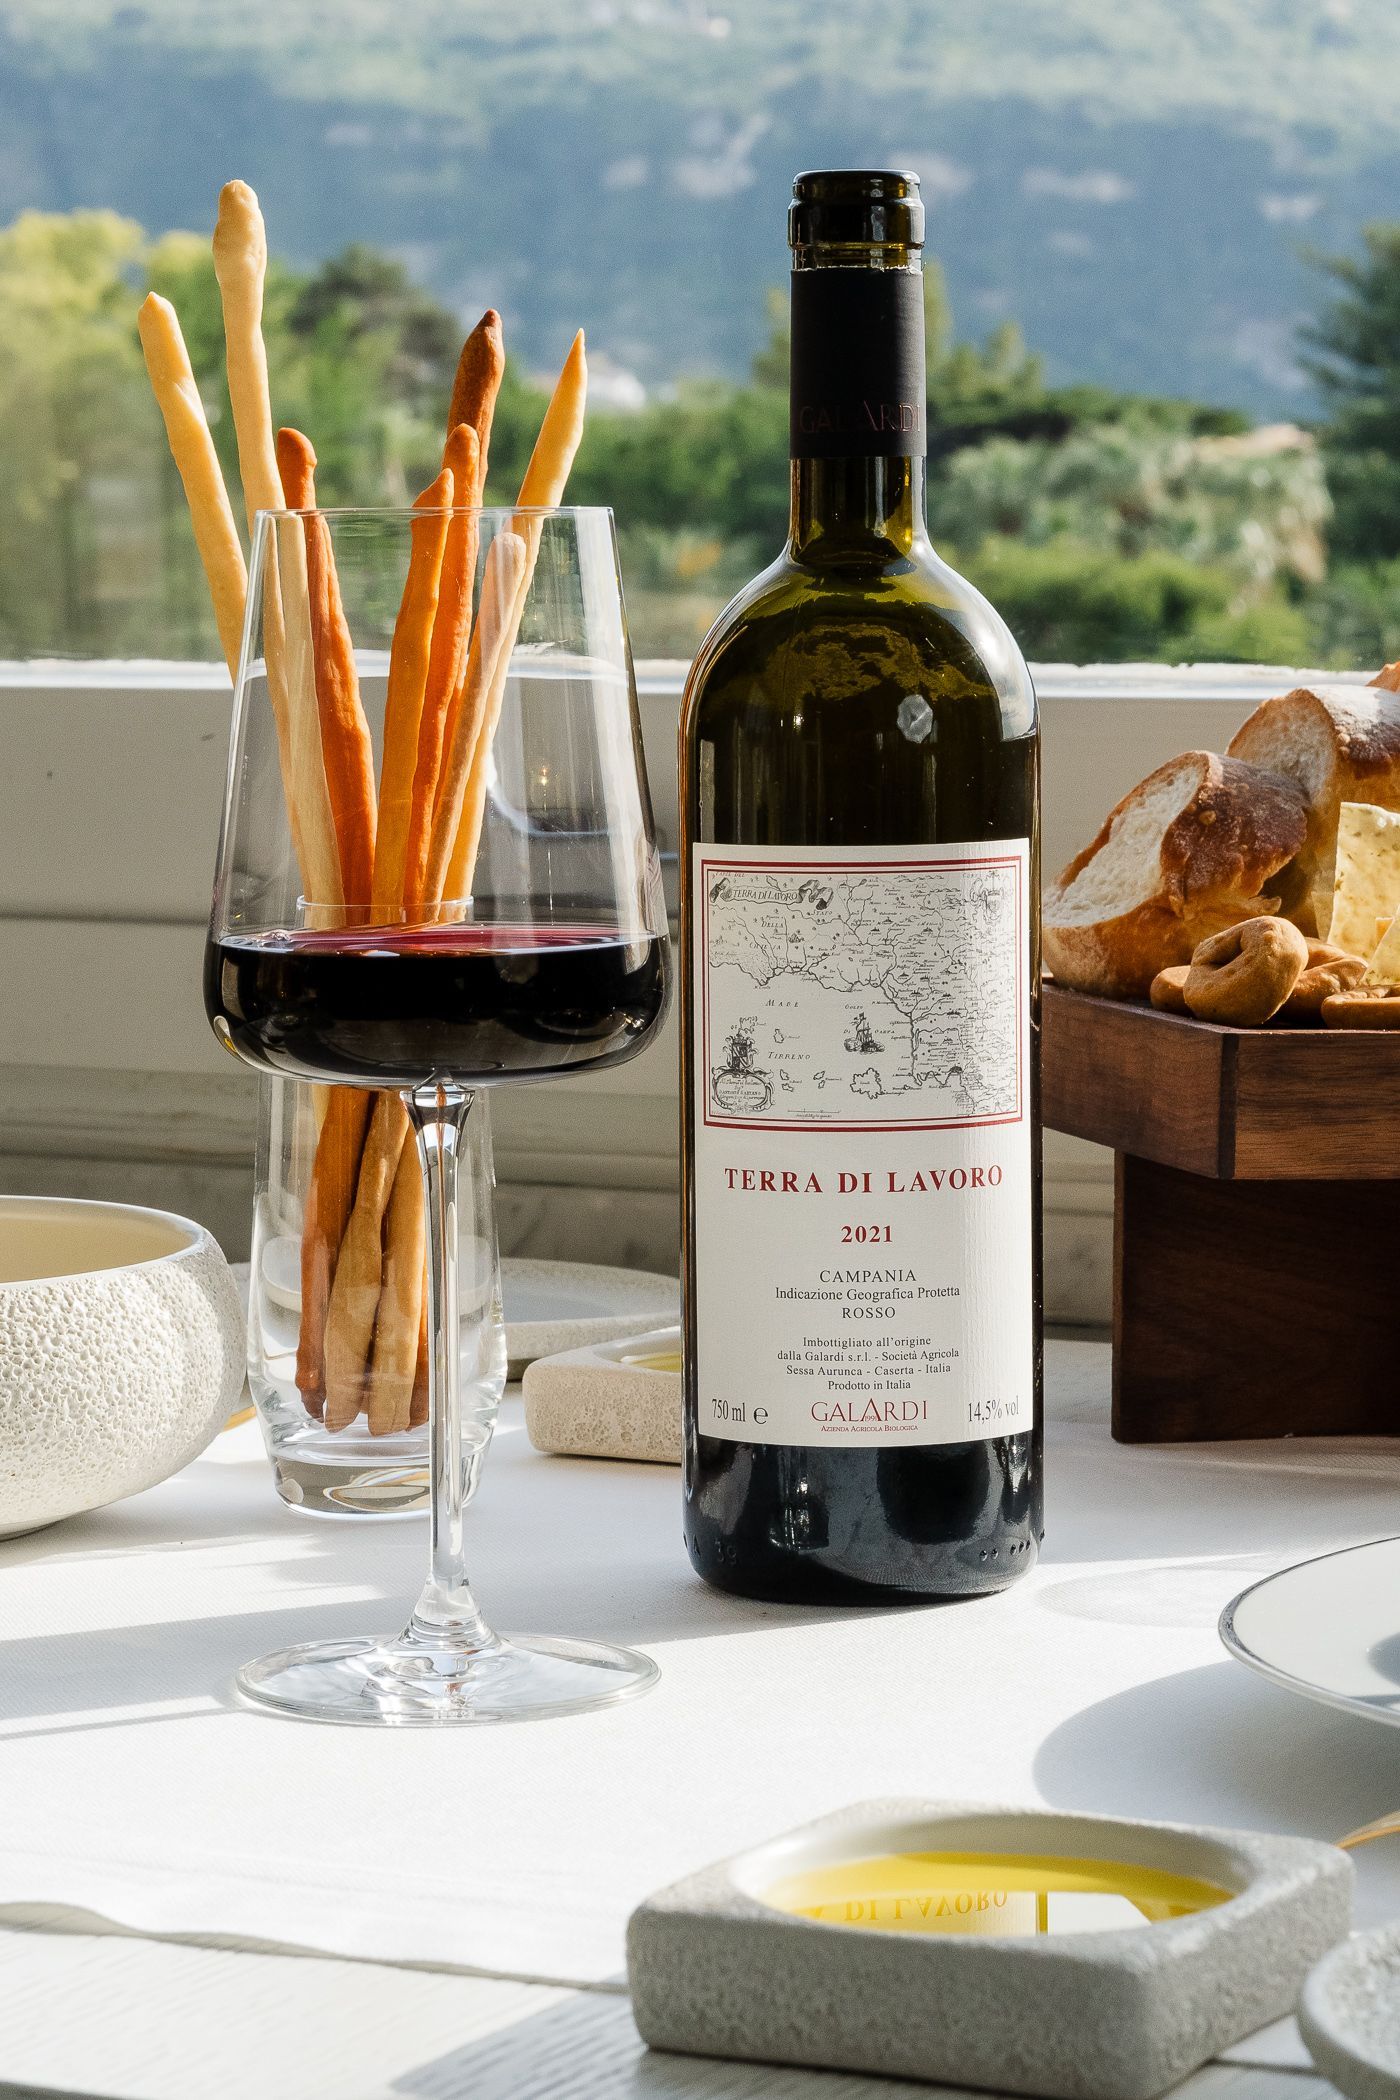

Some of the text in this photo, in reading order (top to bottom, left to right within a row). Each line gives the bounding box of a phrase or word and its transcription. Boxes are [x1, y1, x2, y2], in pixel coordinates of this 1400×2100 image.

[733, 889, 757, 898] TERRA
[725, 1164, 1003, 1194] TERRA DI LAVORO
[841, 1225, 893, 1243] 2021
[819, 1269, 917, 1283] CAMPANIA
[775, 1286, 961, 1303] Indicazione Geografica Protetta
[842, 1306, 896, 1319] ROSSO
[803, 1336, 873, 1349] Imbottigliato
[777, 1350, 802, 1361] dalla
[804, 1351, 845, 1362] Galardi
[847, 1352, 872, 1362] s.r.l.
[881, 1350, 918, 1361] Società
[920, 1347, 960, 1361] Agricola
[786, 1364, 815, 1376] Sessa
[817, 1366, 863, 1376] Aurunca
[874, 1365, 914, 1376] Caserta
[925, 1362, 951, 1374] Italia
[827, 1379, 911, 1391] Prodotto in Italia
[712, 1398, 729, 1420] 750
[731, 1402, 746, 1422] ml
[811, 1397, 927, 1422] GALARDI
[968, 1395, 1019, 1424] 14,5% vol
